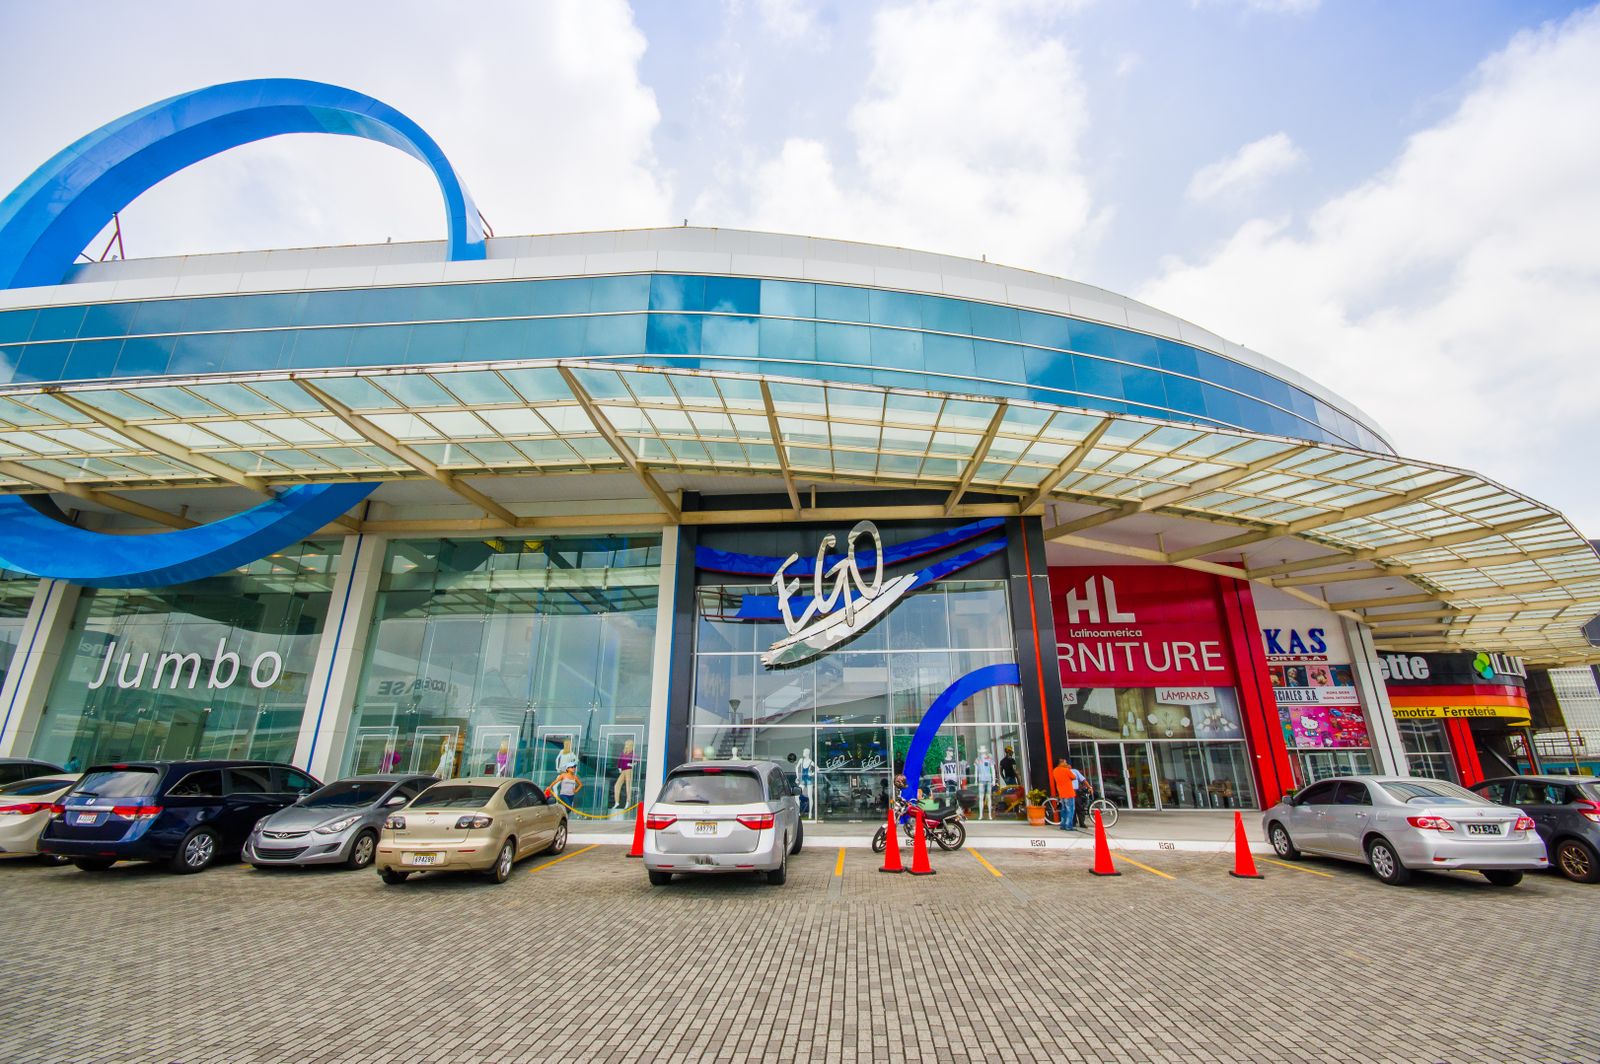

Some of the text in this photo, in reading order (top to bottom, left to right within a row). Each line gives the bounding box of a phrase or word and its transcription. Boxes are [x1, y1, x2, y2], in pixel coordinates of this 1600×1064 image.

[771, 520, 883, 634] EGO
[1066, 575, 1136, 624] HL
[1070, 628, 1143, 638] Latinoamerica
[1262, 628, 1327, 654] KAS
[1056, 641, 1225, 672] RNITURE
[88, 637, 282, 690] Jumbo
[1378, 654, 1430, 680] ette
[1161, 690, 1210, 700] LÁMPARAS
[1392, 707, 1437, 717] omotriz
[861, 754, 881, 769] EGO
[944, 764, 956, 774] NY
[1469, 824, 1500, 834] AJ1342
[1030, 839, 1046, 848] EGO
[1158, 840, 1175, 850] EGO
